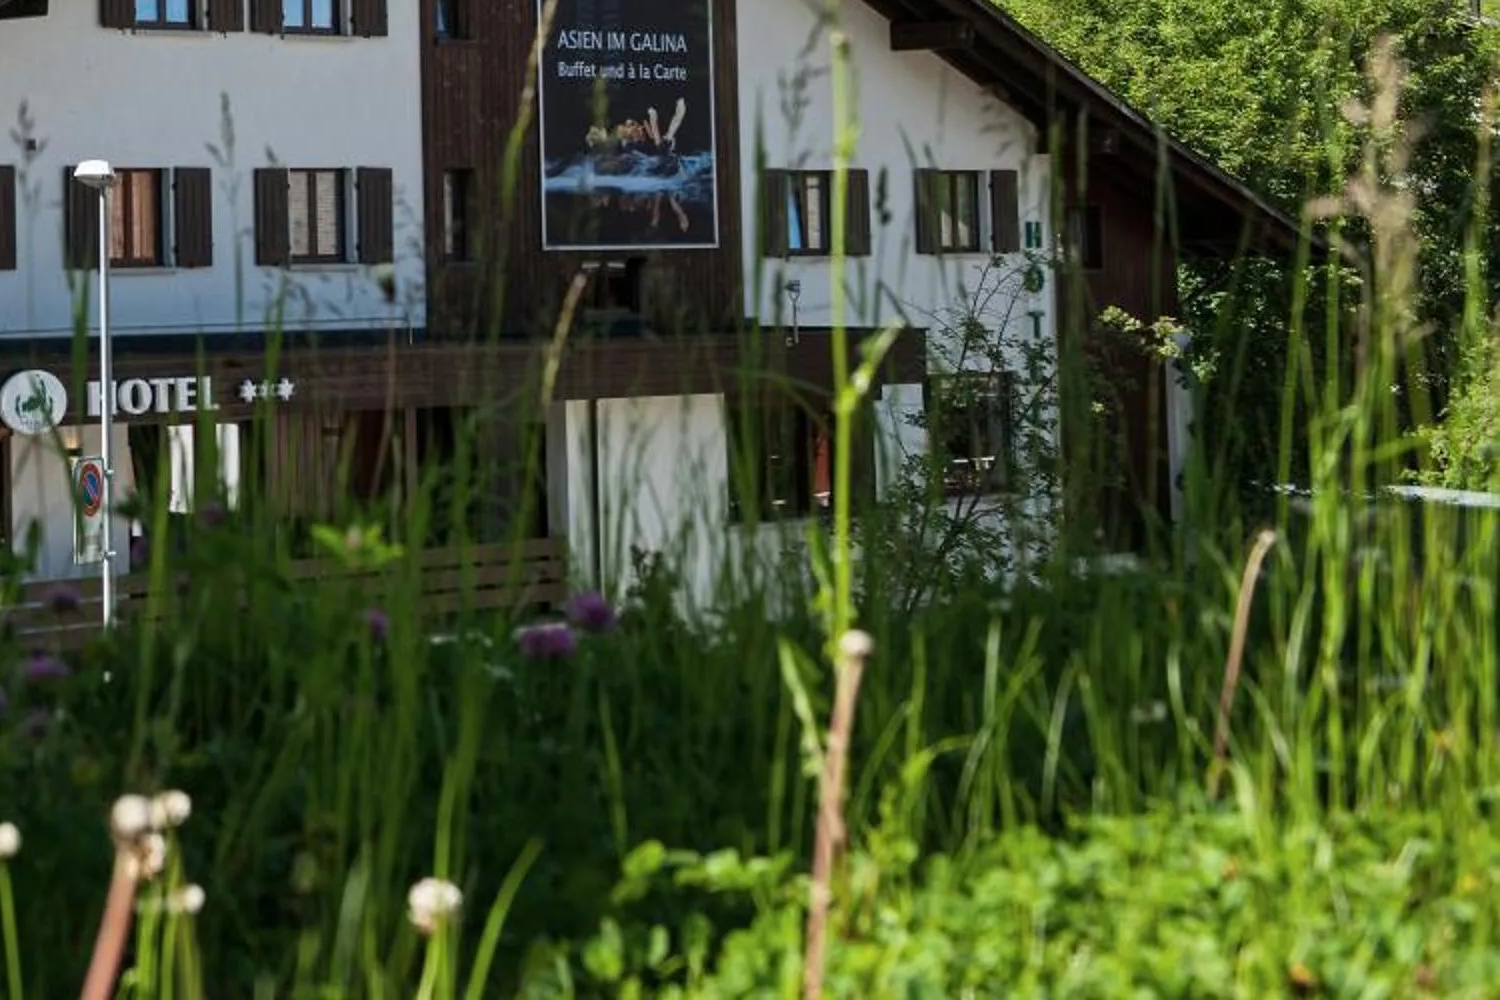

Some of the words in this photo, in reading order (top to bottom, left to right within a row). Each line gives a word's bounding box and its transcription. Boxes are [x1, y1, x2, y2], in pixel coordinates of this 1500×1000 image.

[557, 28, 602, 50] ASIEN
[607, 31, 625, 51] IM
[629, 32, 688, 53] GALINA
[557, 61, 596, 78] Buffet
[628, 62, 637, 79] à
[639, 63, 651, 80] la
[653, 63, 688, 81] Carte
[87, 376, 220, 417] HOTEL
